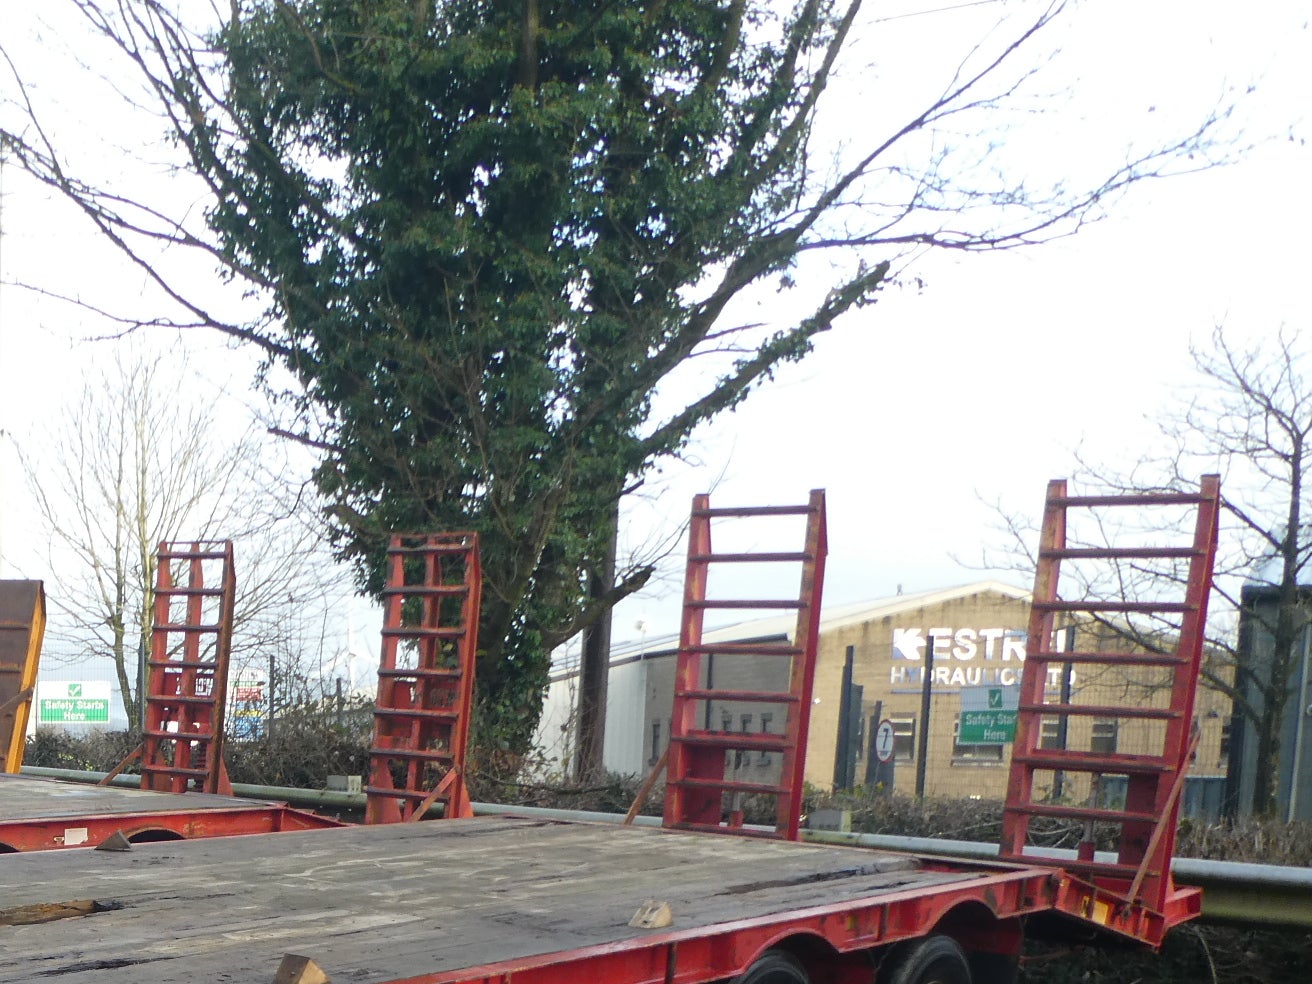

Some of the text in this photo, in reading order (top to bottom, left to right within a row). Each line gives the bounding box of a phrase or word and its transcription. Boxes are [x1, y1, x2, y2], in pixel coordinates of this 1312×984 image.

[45, 700, 104, 712] Safety Starts
[63, 711, 85, 721] Here
[965, 713, 995, 728] Safety
[882, 727, 889, 749] 7
[983, 729, 1006, 741] Here
